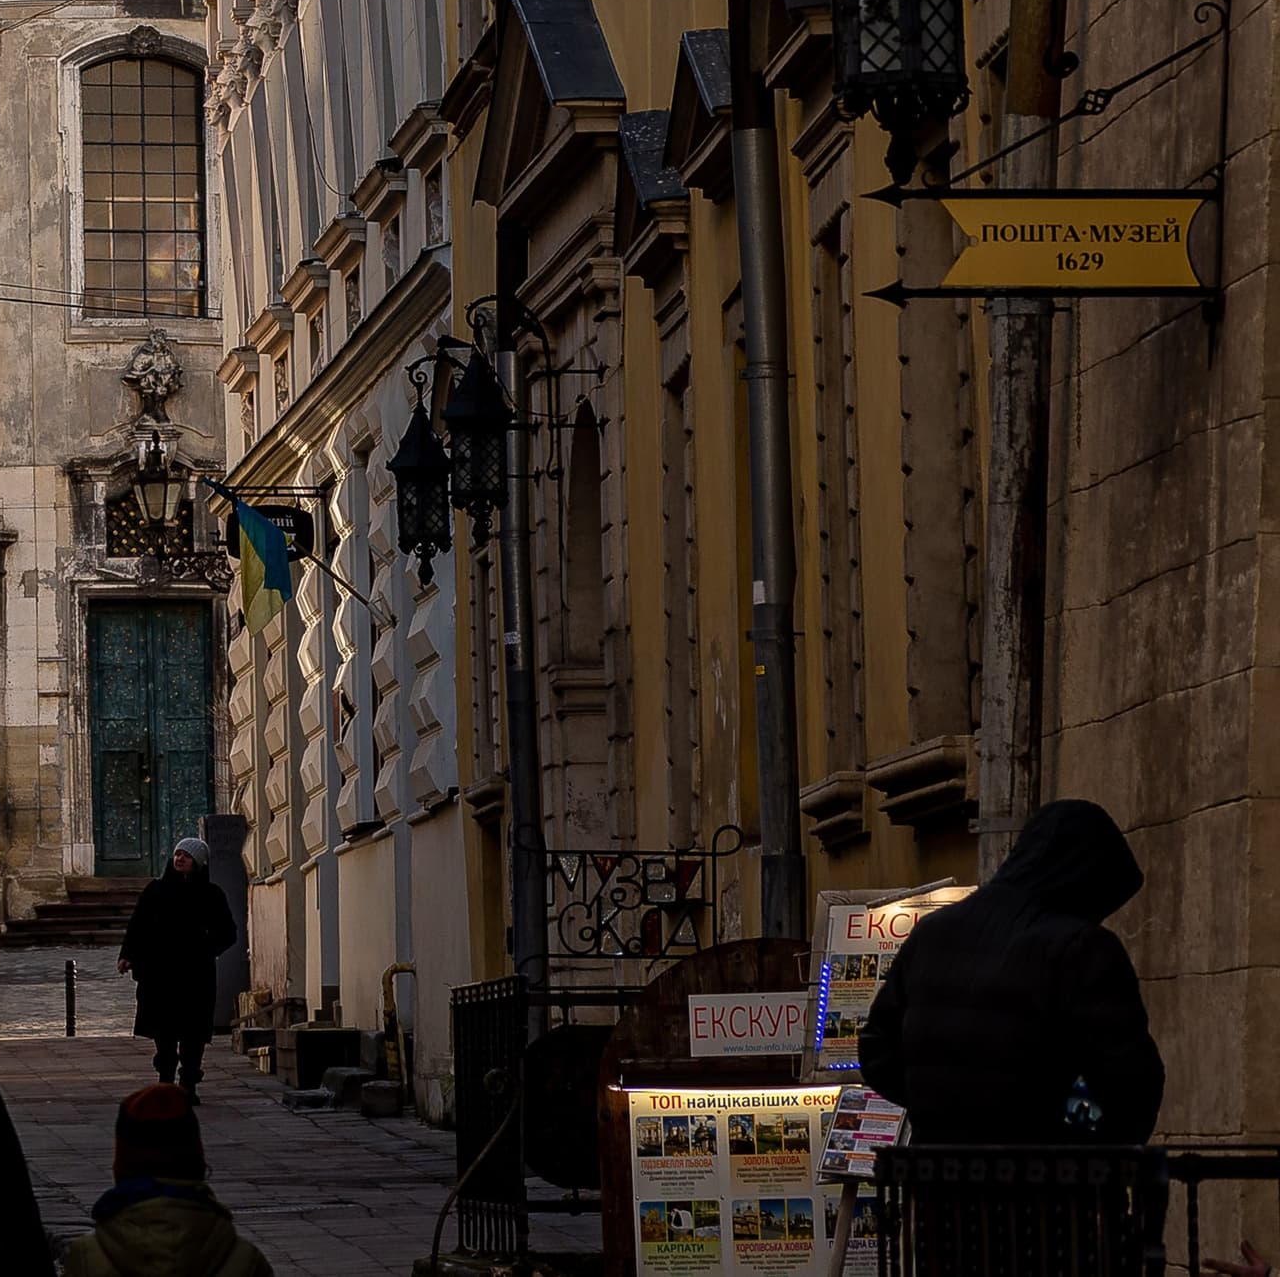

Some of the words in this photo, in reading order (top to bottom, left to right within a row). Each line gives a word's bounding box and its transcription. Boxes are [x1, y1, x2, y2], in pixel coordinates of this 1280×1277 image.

[1056, 252, 1104, 271] 1629
[650, 1095, 682, 1110] ТОП
[687, 1093, 799, 1110] найцікавіших
[656, 1243, 705, 1253] КАРПАТИ
